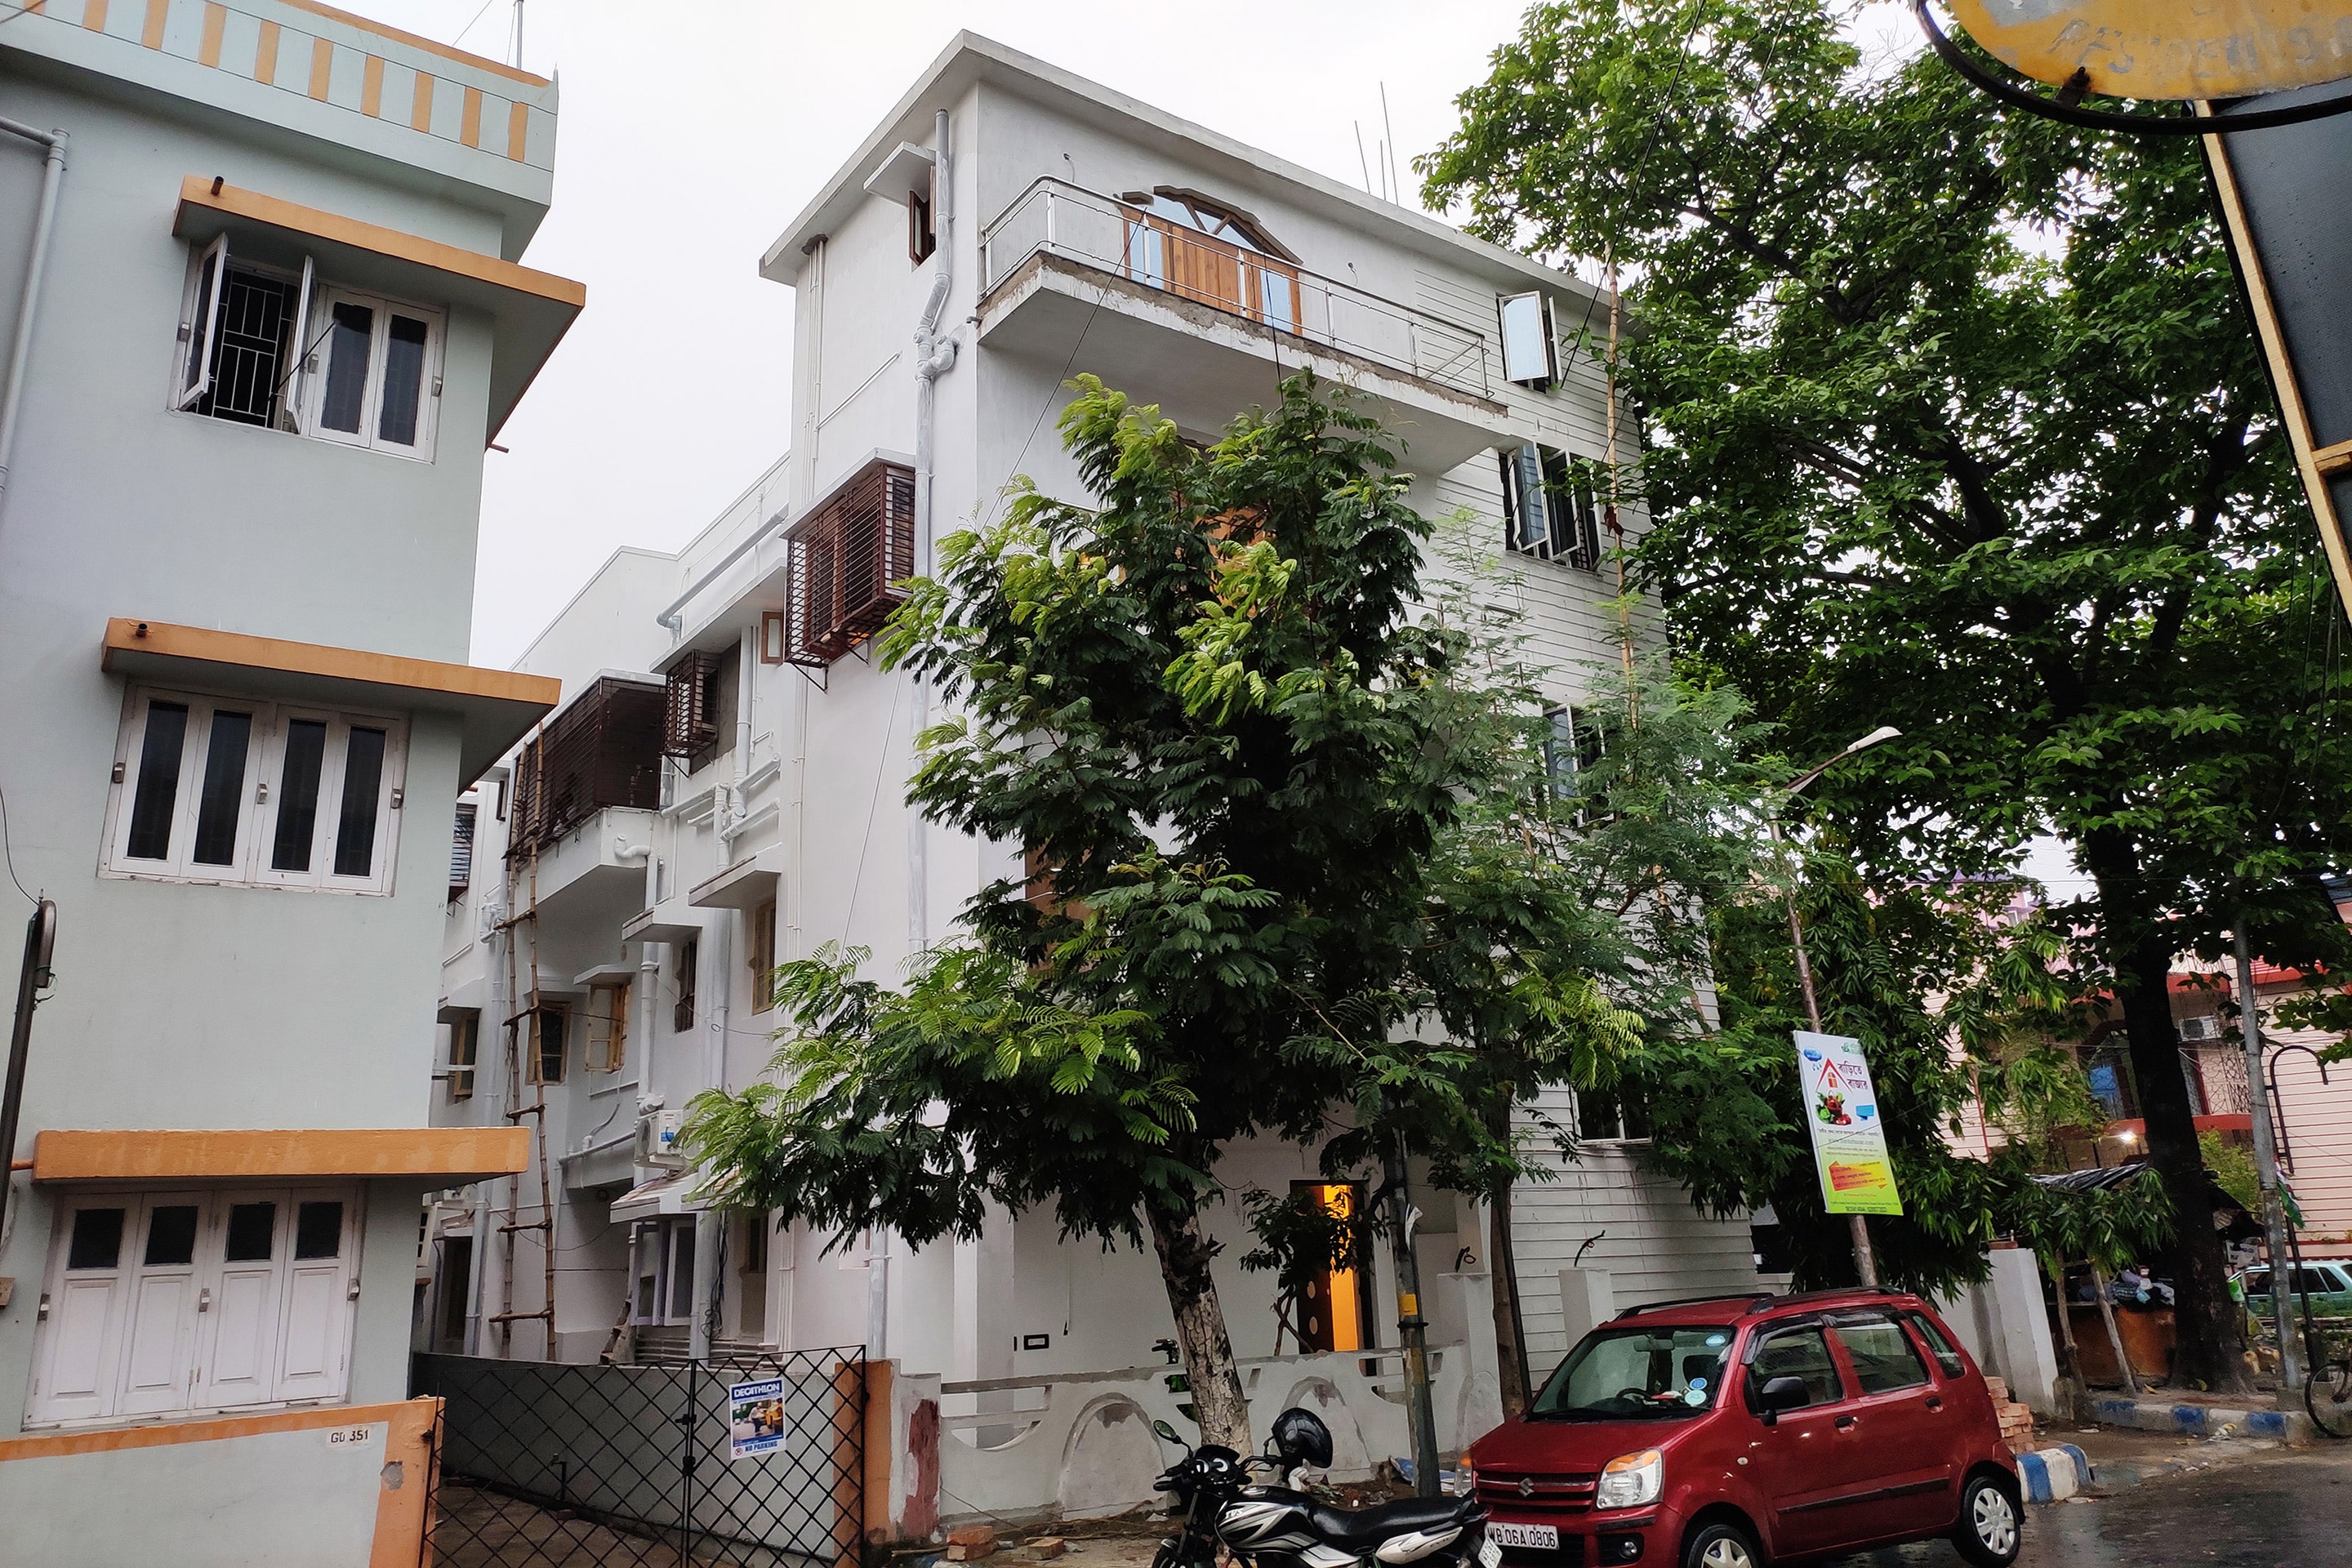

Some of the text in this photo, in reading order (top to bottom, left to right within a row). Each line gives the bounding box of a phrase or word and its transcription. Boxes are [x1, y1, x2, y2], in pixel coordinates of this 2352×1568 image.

[1837, 1060, 1862, 1076] বাড়িতে
[1846, 1078, 1868, 1090] বাজার
[734, 1383, 780, 1398] DECATHLON
[350, 1429, 368, 1441] 351
[754, 1441, 778, 1450] PARKING
[1487, 1526, 1556, 1548] WB 06A 0806
